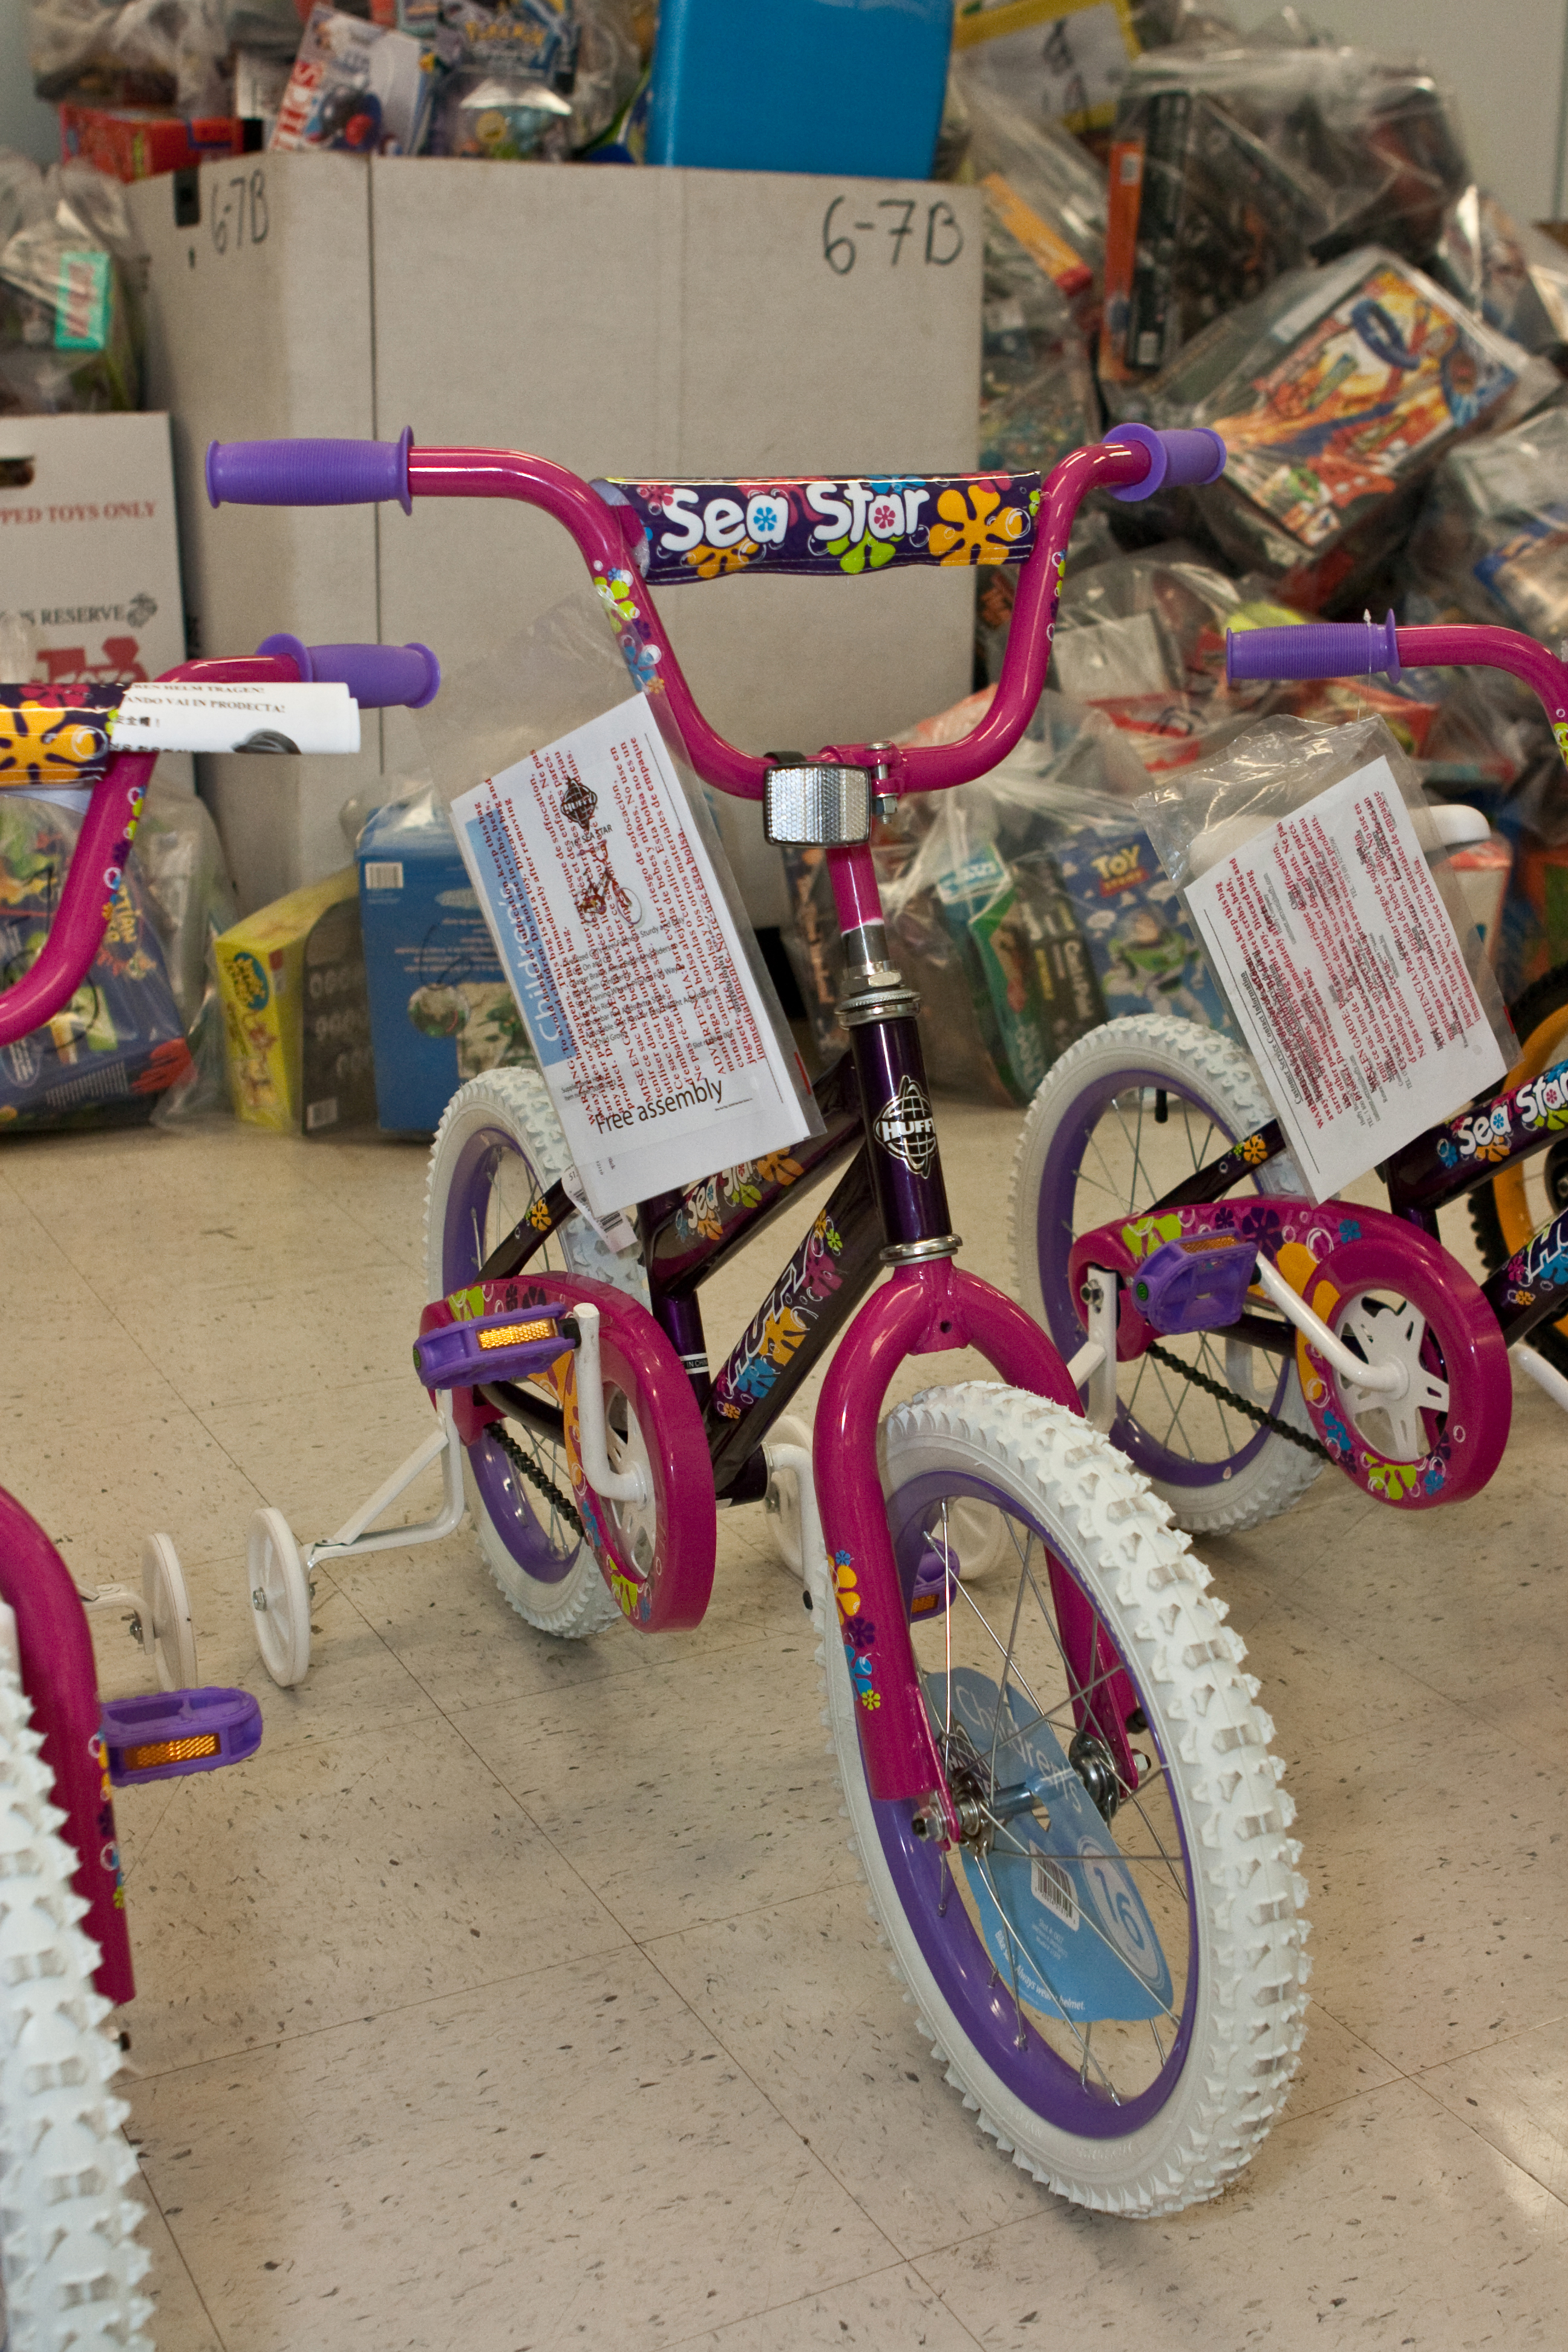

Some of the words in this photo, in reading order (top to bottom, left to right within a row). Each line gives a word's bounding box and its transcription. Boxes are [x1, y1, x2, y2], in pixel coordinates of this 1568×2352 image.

[210, 169, 270, 255] 6-7B
[822, 195, 964, 275] 6-7B
[48, 505, 99, 523] TOYS
[103, 501, 156, 521] ONLY
[660, 487, 789, 551] Sea
[806, 482, 931, 543] Star
[41, 604, 126, 626] RESERVE
[529, 746, 544, 769] pas
[544, 753, 563, 788] parcs.
[630, 737, 654, 792] empaque
[484, 777, 498, 800] and
[616, 763, 627, 785] use
[474, 802, 488, 825] bag
[485, 800, 500, 833] beds,
[494, 800, 506, 825] bag
[529, 774, 558, 844] suffocation,
[547, 791, 567, 838] enfants.
[612, 780, 639, 849] sofocación,
[638, 792, 654, 826] bolsa
[1359, 815, 1369, 832] use
[1374, 791, 1397, 833] empaque
[482, 825, 494, 848] this
[504, 797, 529, 854] removing
[650, 826, 665, 854] Esta
[1276, 822, 1287, 838] pas
[1289, 821, 1306, 851] parcs.
[1299, 818, 1322, 860] matériau
[501, 825, 524, 872] Discard
[564, 840, 575, 860] des
[656, 810, 685, 874] materiales
[491, 850, 505, 877] keep
[525, 856, 540, 883] after
[648, 854, 665, 890] bebes
[1090, 844, 1140, 880] TOY
[1229, 858, 1240, 875] and
[1396, 846, 1419, 894] materiales
[512, 880, 524, 901] use
[520, 874, 532, 896] toy.
[561, 861, 580, 898] risque
[641, 867, 660, 904] riesgo
[662, 855, 689, 920] corralitos.
[681, 875, 697, 907] otros
[690, 864, 705, 890] ésta
[1215, 881, 1226, 901] bag
[1236, 874, 1247, 895] bag
[1334, 871, 1349, 898] enlevé
[1221, 900, 1233, 919] this
[1379, 896, 1395, 924] riesgo
[1386, 883, 1401, 911] bebes
[1416, 893, 1429, 918] otros
[521, 903, 532, 923] not
[531, 906, 543, 925] not
[536, 886, 566, 956] immediately
[694, 909, 705, 928] los
[1242, 893, 1263, 931] Discard
[1303, 912, 1320, 941] risque
[563, 926, 575, 953] bag.
[668, 907, 690, 950] alejada
[1230, 919, 1245, 942] keep
[1319, 920, 1334, 947] bébés
[1403, 922, 1421, 955] alejada
[545, 938, 557, 961] bag
[689, 930, 714, 983] carriolas
[705, 938, 722, 971] bolsa
[1316, 941, 1329, 961] tout
[1331, 946, 1340, 962] des
[1435, 939, 1448, 965] bolsa
[537, 944, 558, 996] children.
[553, 961, 566, 988] This
[685, 952, 702, 985] bolsa
[1275, 938, 1305, 993] immediately
[1416, 955, 1430, 981] bolsa
[530, 960, 552, 1004] danger
[1241, 972, 1262, 1016] Information
[1427, 979, 1438, 998] esta
[1448, 973, 1459, 995] Tire
[554, 999, 567, 1022] and
[699, 986, 713, 1010] esta
[723, 985, 736, 1013] Tire
[1377, 1004, 1390, 1021] pas
[546, 1004, 564, 1038] avoid
[1258, 1014, 1276, 1044] Contact
[1356, 1013, 1368, 1035] hors
[1373, 1023, 1385, 1044] dans
[1434, 998, 1456, 1041] mantenga
[563, 1022, 582, 1060] babies
[634, 1033, 646, 1052] sac
[642, 1021, 656, 1049] dans
[653, 1022, 669, 1050] n'est
[710, 1013, 735, 1072] mantenga
[1365, 1034, 1375, 1050] sac
[665, 1052, 677, 1071] sac
[685, 1042, 699, 1063] pas
[1272, 1042, 1287, 1071] Service
[580, 1062, 593, 1091] from
[600, 1061, 616, 1091] other
[612, 1060, 635, 1111] product.
[634, 1068, 653, 1103] MISE
[647, 1070, 663, 1099] tenir
[653, 1052, 673, 1094] utiliser
[1284, 1070, 1302, 1105] Customer
[1331, 1069, 1345, 1091] other
[594, 1103, 635, 1134] Free
[633, 1071, 722, 1122] assembly
[612, 1094, 626, 1114] any
[1320, 1074, 1343, 1114] carriages
[1516, 1070, 1568, 1123] Star
[1458, 1104, 1512, 1155] Sea
[688, 1175, 719, 1229] Sea
[1088, 1866, 1145, 1951] 16
[1016, 1964, 1037, 1991] Always
[1060, 1994, 1086, 2011] helmet.
